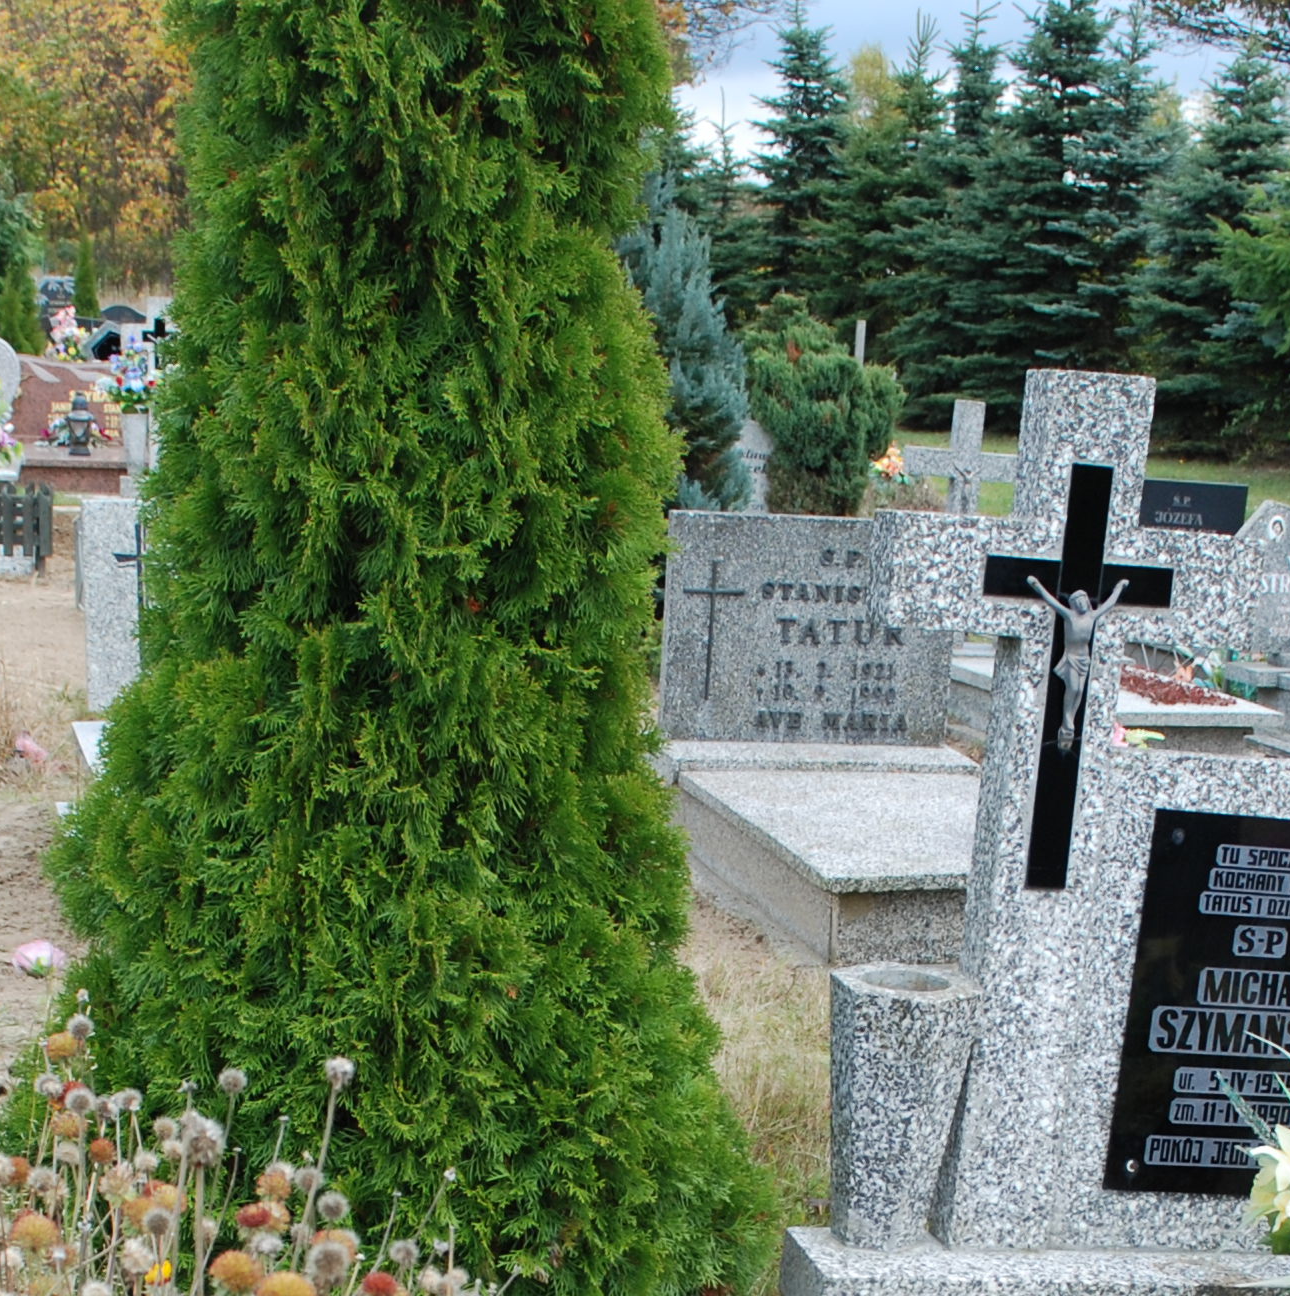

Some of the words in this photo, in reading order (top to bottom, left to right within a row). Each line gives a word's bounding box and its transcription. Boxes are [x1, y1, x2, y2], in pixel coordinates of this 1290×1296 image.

[1154, 507, 1203, 527] JÓZEFA
[761, 582, 867, 604] STANIS
[821, 711, 909, 731] MARIA
[1221, 846, 1241, 865] TU
[1213, 870, 1286, 893] KOCHANY
[1256, 897, 1263, 915] I
[1178, 1072, 1195, 1091] ur.
[1173, 1103, 1198, 1122] zm.
[1149, 1138, 1204, 1164] POKÓJ
